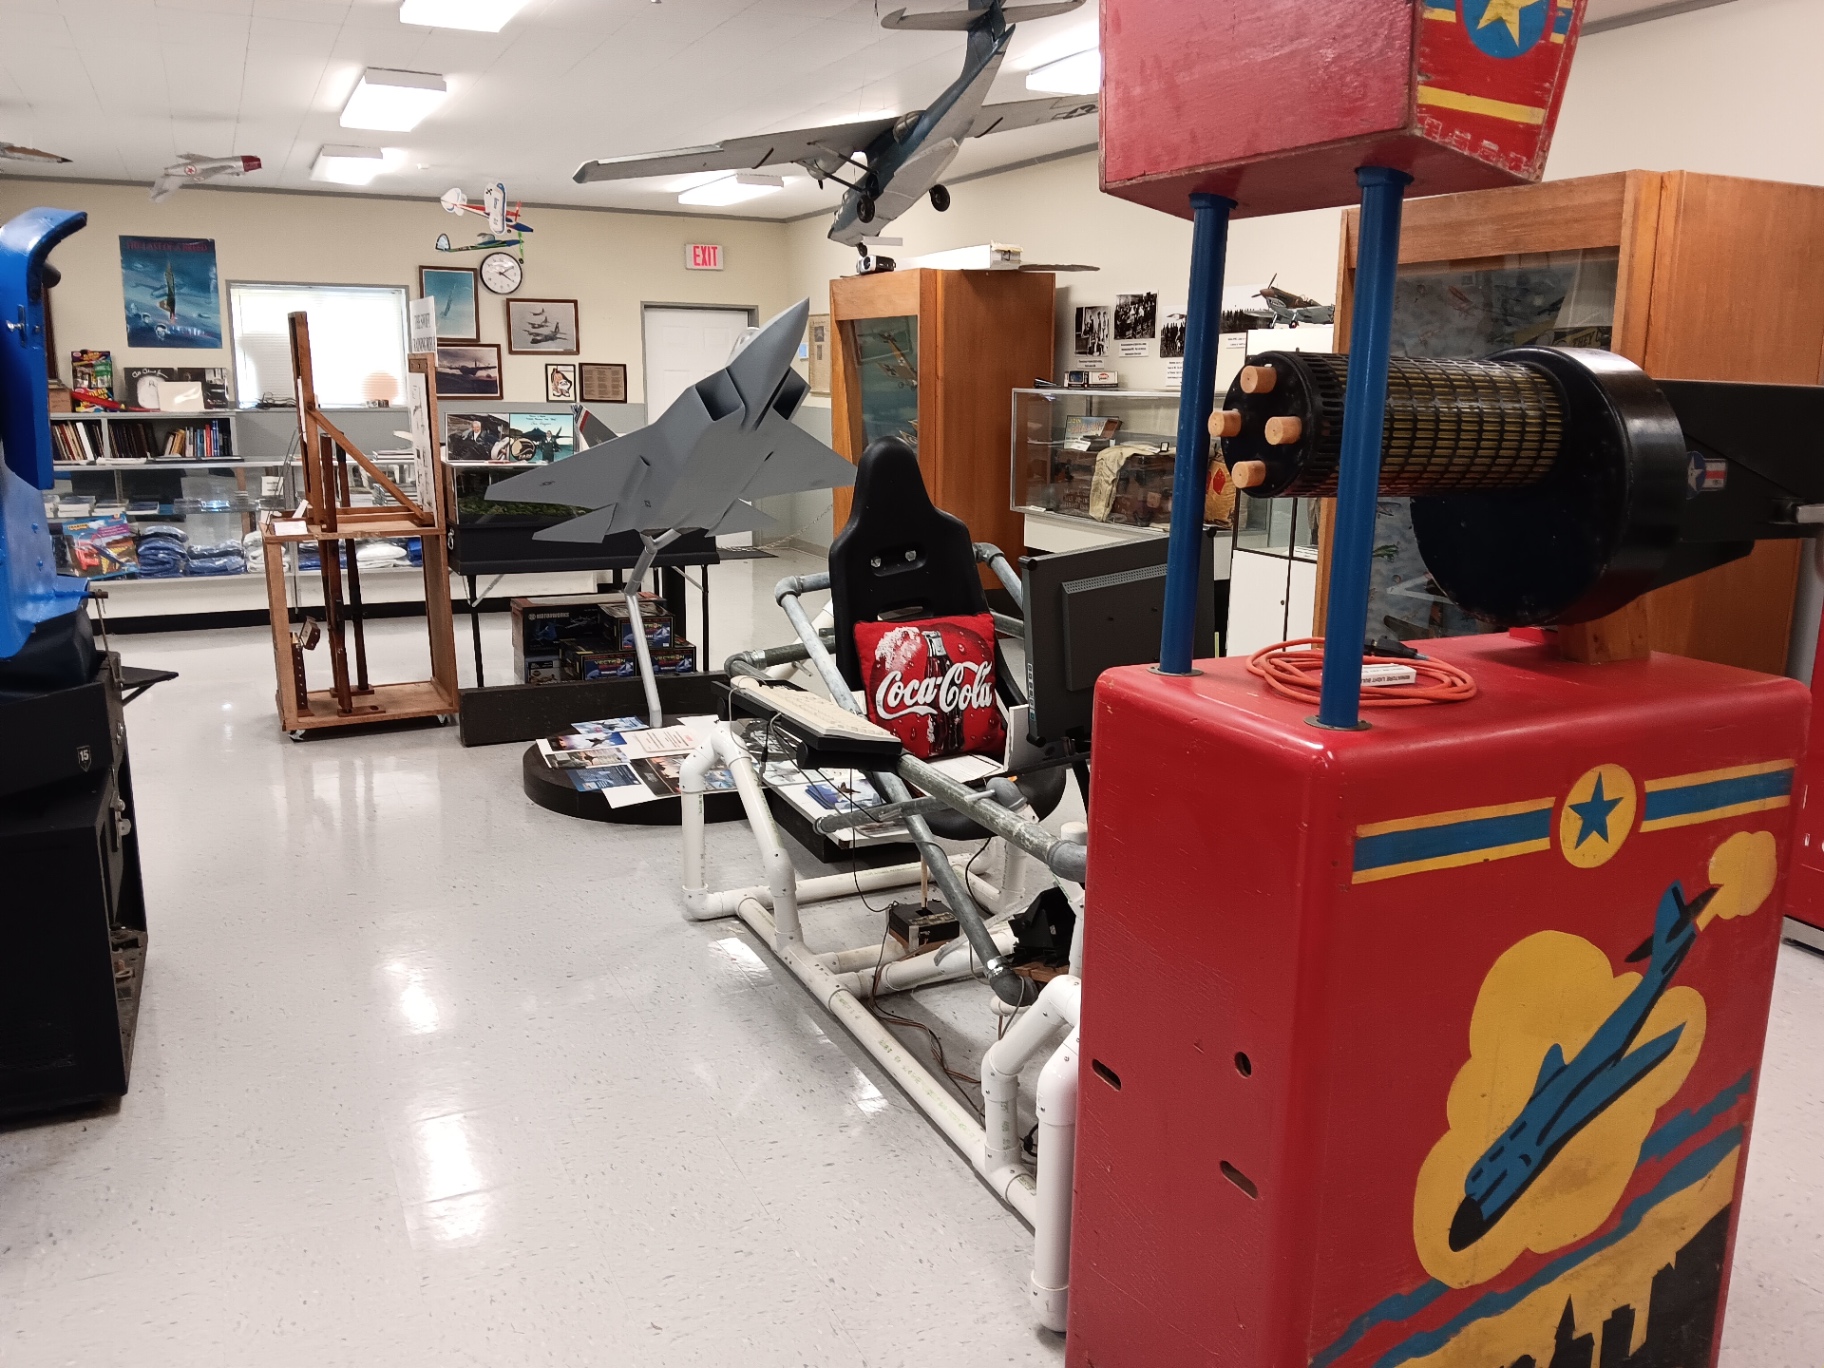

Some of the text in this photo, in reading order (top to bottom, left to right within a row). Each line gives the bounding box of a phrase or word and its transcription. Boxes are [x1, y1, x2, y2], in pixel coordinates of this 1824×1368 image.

[693, 246, 718, 266] EXIT
[875, 661, 993, 720] Coca-Cola
[80, 749, 89, 761] 15
